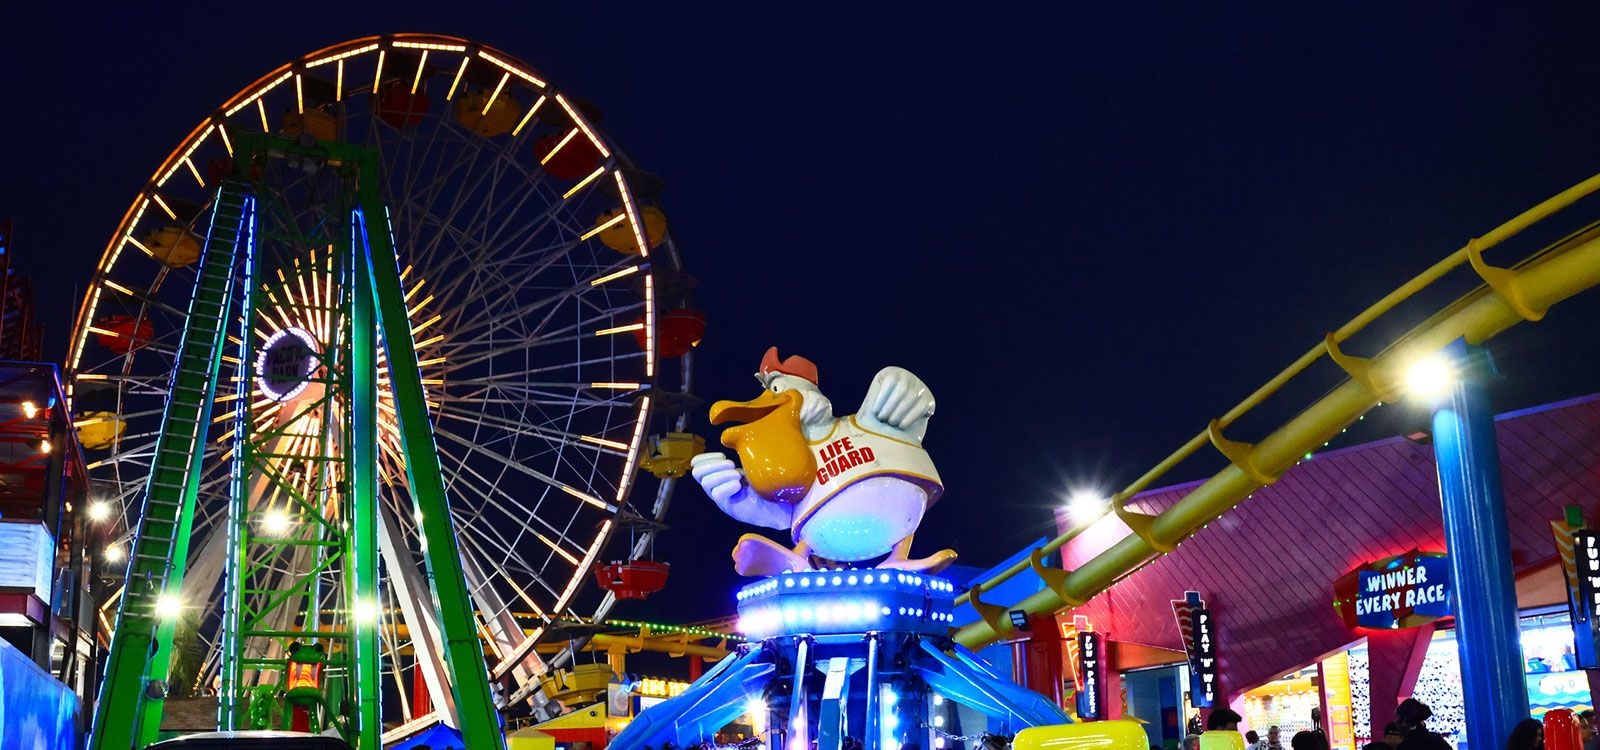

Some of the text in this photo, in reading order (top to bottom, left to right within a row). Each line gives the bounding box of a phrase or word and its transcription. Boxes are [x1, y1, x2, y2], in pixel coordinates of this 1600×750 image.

[819, 436, 854, 463] LIFE
[816, 447, 875, 485] GUARD
[1587, 536, 1600, 570] FUN
[1367, 566, 1427, 592] WINNER
[1356, 584, 1445, 615] EVERY RACE
[1085, 635, 1093, 658] FUN
[1200, 614, 1210, 653] PLAY
[1087, 670, 1096, 714] PRIZES
[1203, 673, 1214, 702] WIN
